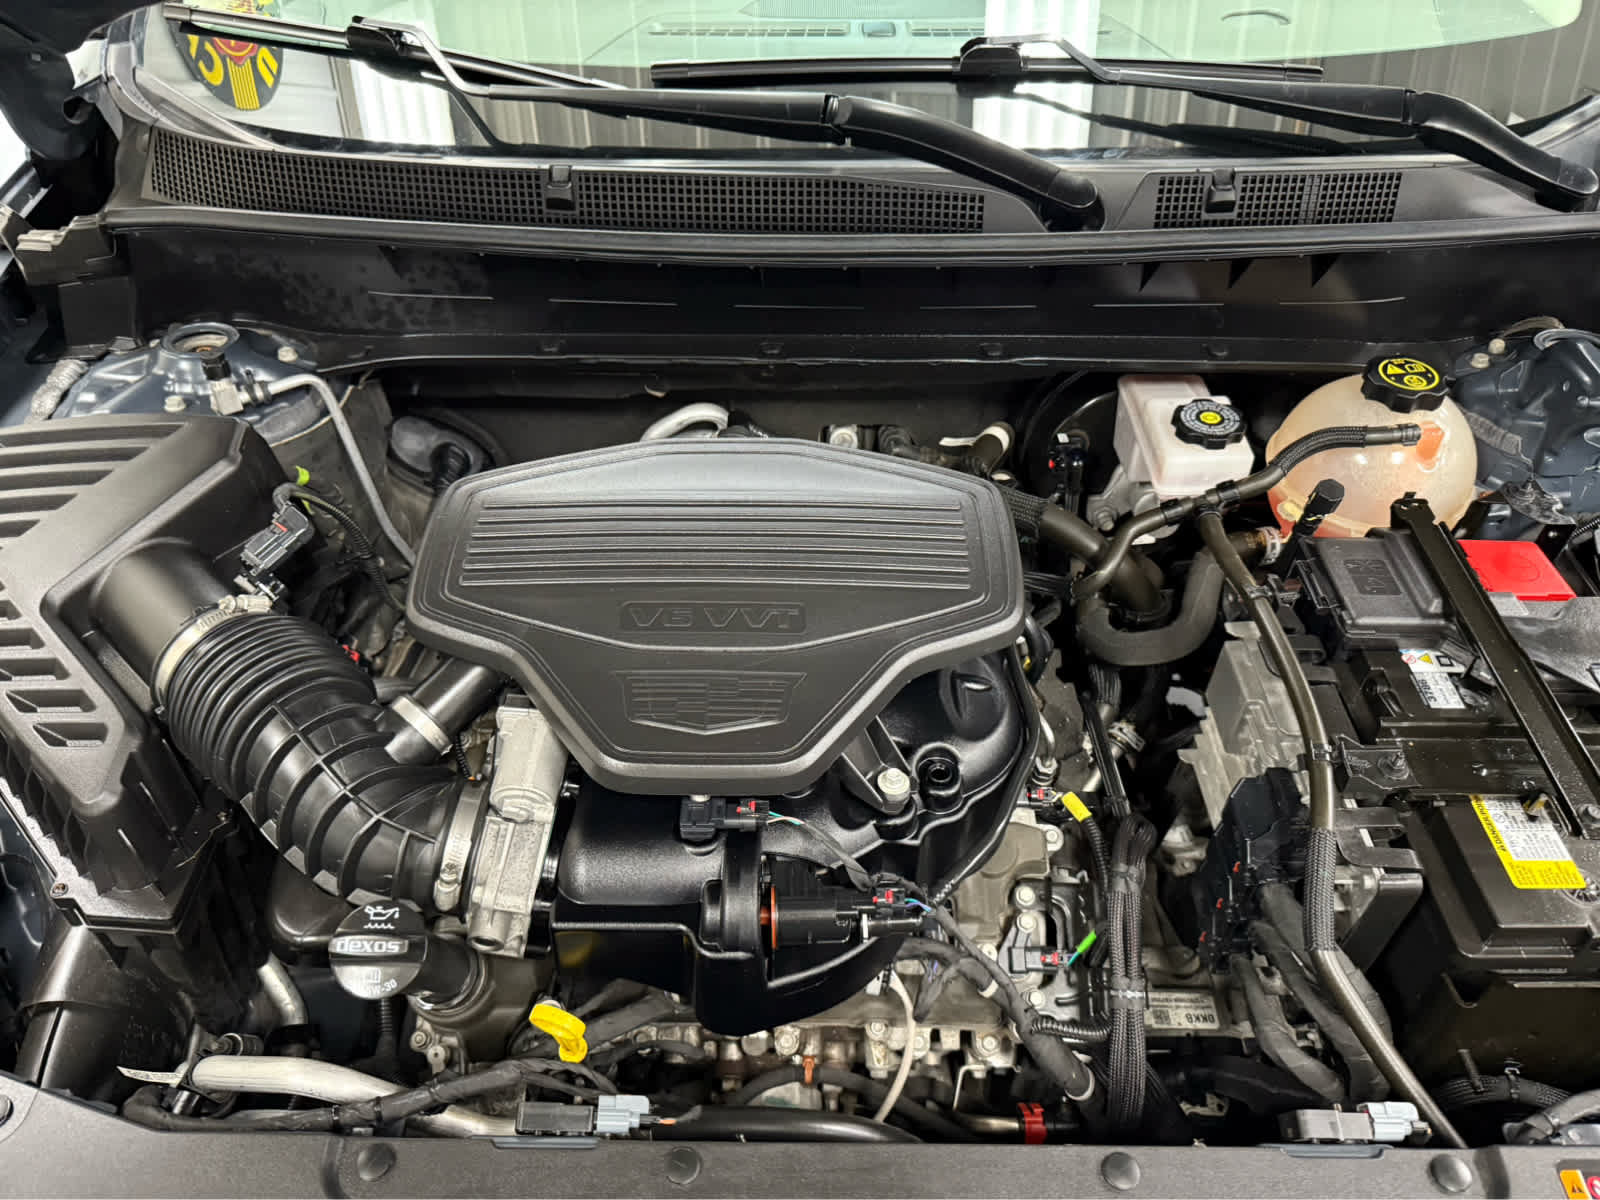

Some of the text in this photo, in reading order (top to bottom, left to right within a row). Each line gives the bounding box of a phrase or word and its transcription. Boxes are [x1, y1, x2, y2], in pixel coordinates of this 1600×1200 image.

[629, 607, 799, 628] V6 VVT
[335, 938, 402, 953] dexos
